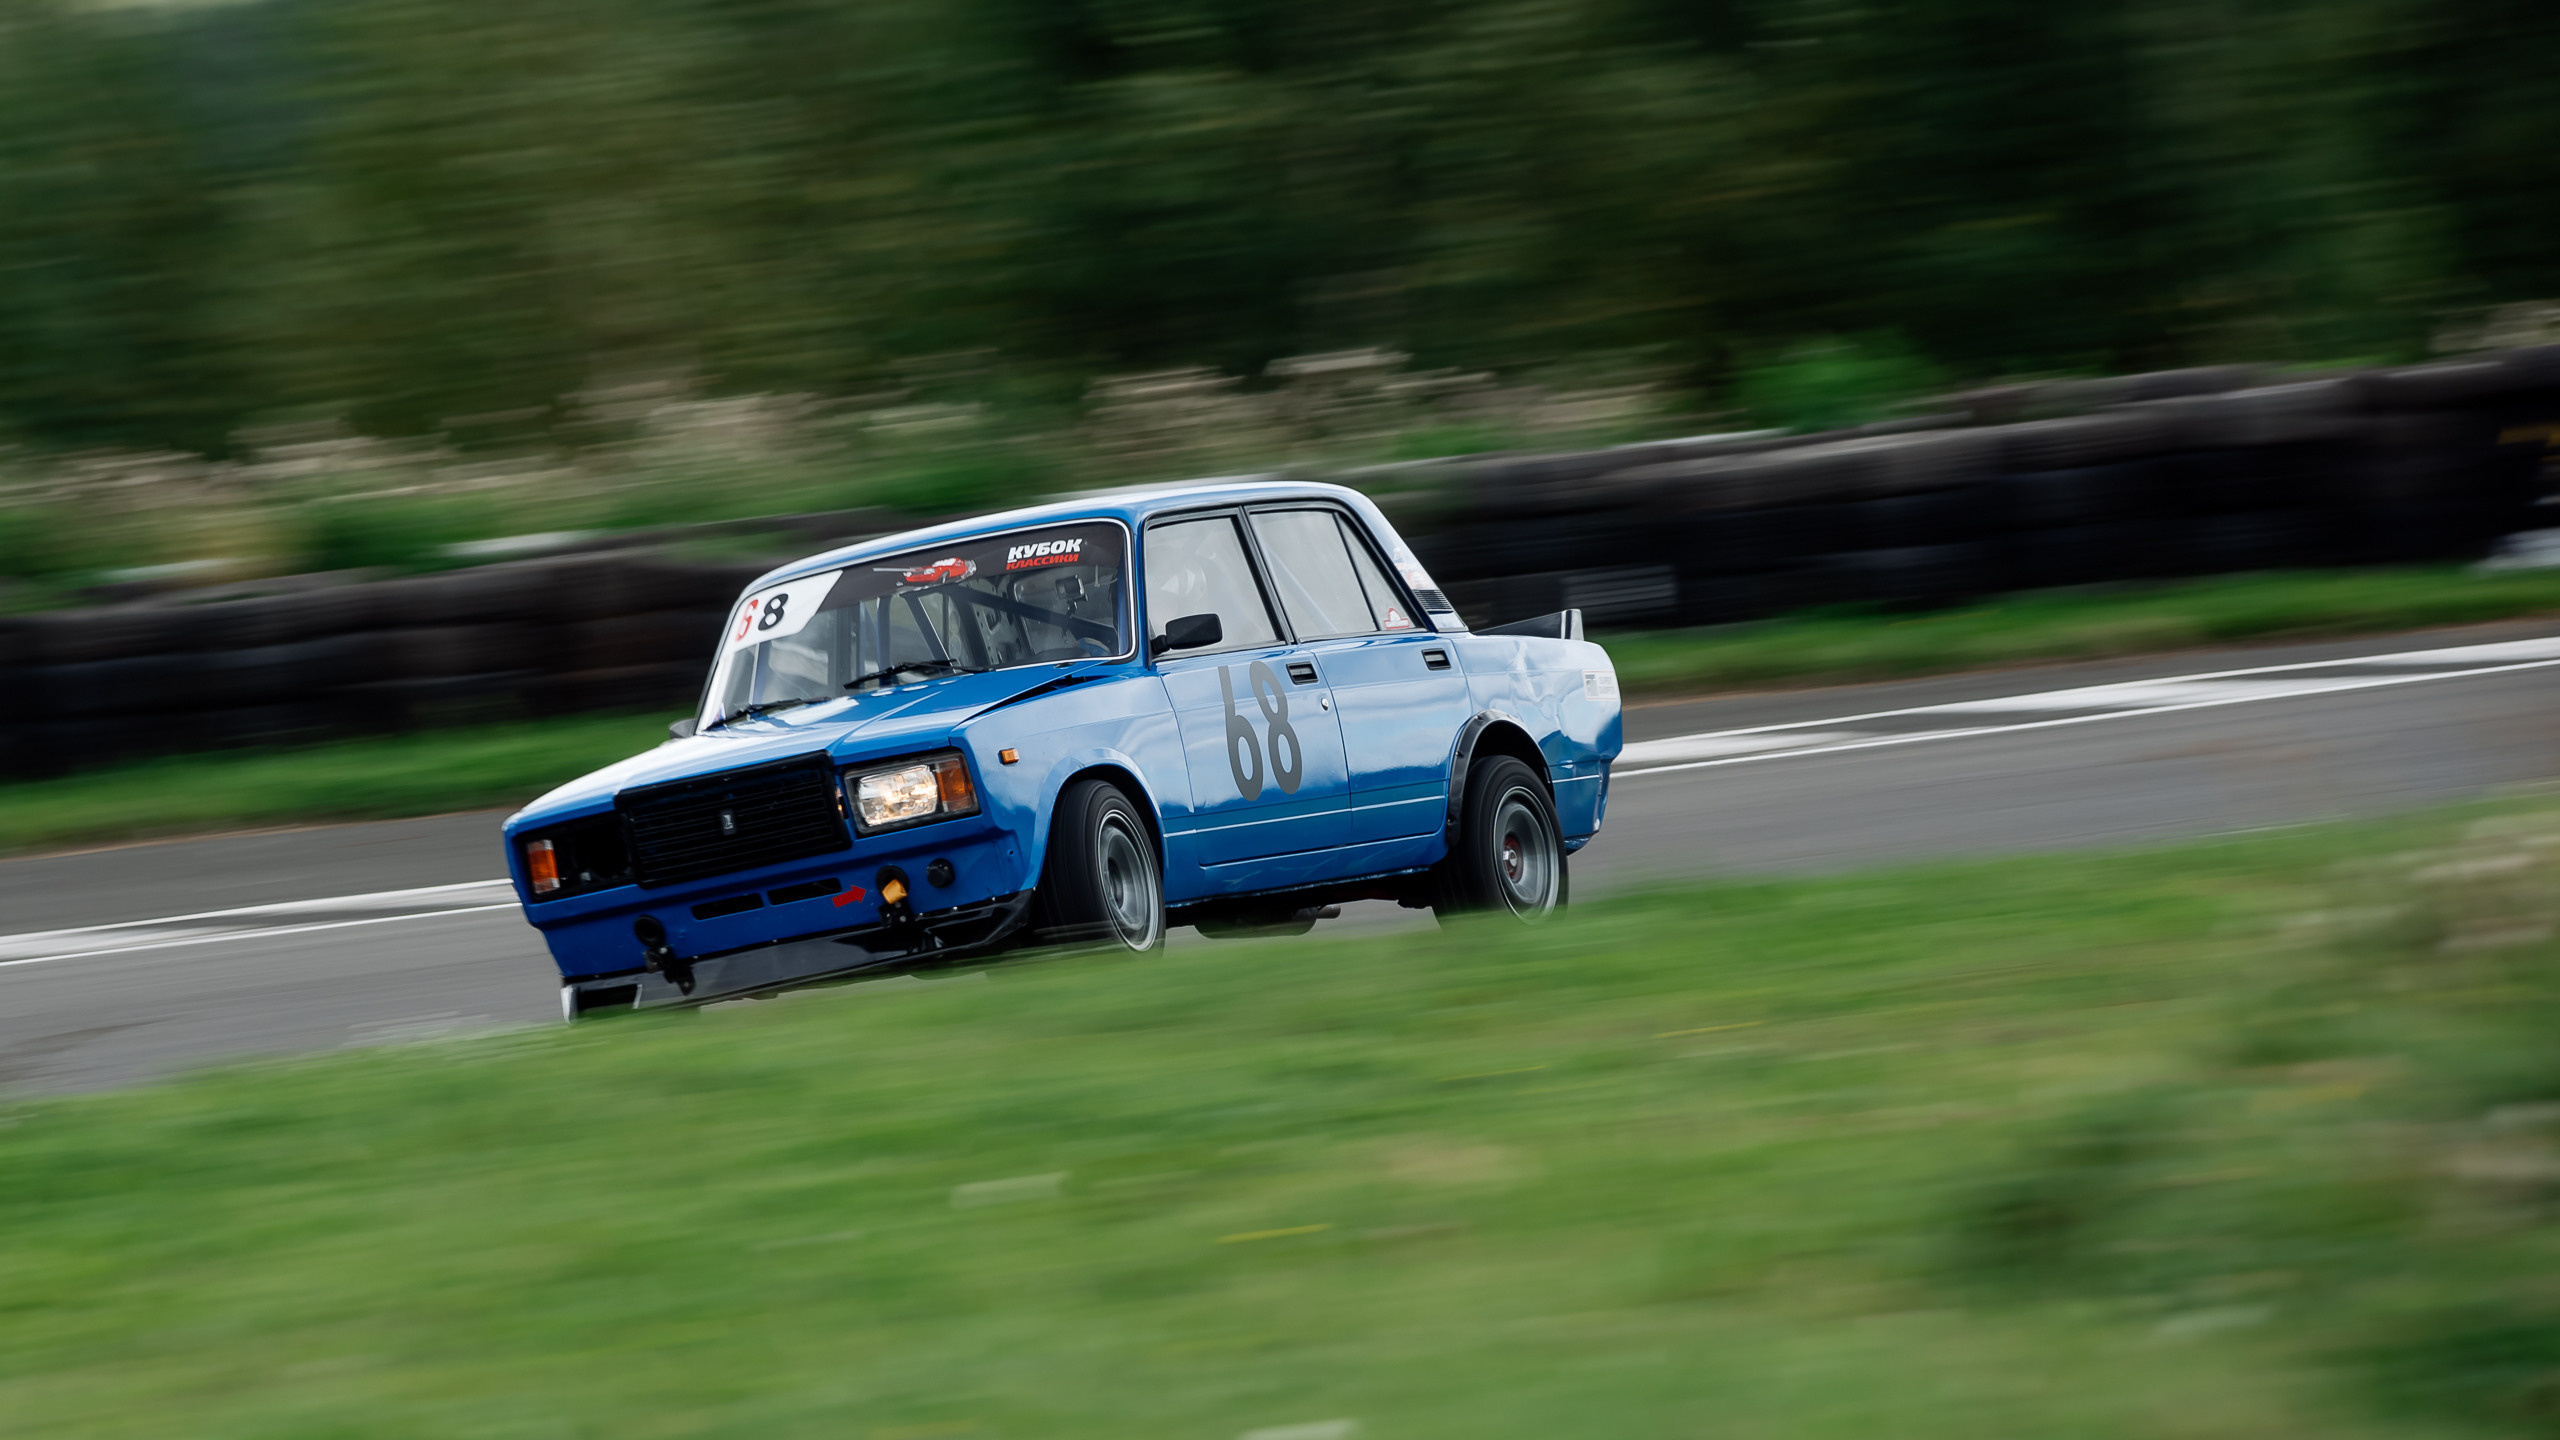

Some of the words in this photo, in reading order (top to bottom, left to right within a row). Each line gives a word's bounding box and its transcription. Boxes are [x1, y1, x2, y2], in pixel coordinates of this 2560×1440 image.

[1006, 553, 1079, 571] КЛАССИКИ
[1007, 538, 1082, 563] КУБОК
[735, 593, 789, 642] 68
[1217, 660, 1302, 801] 68
